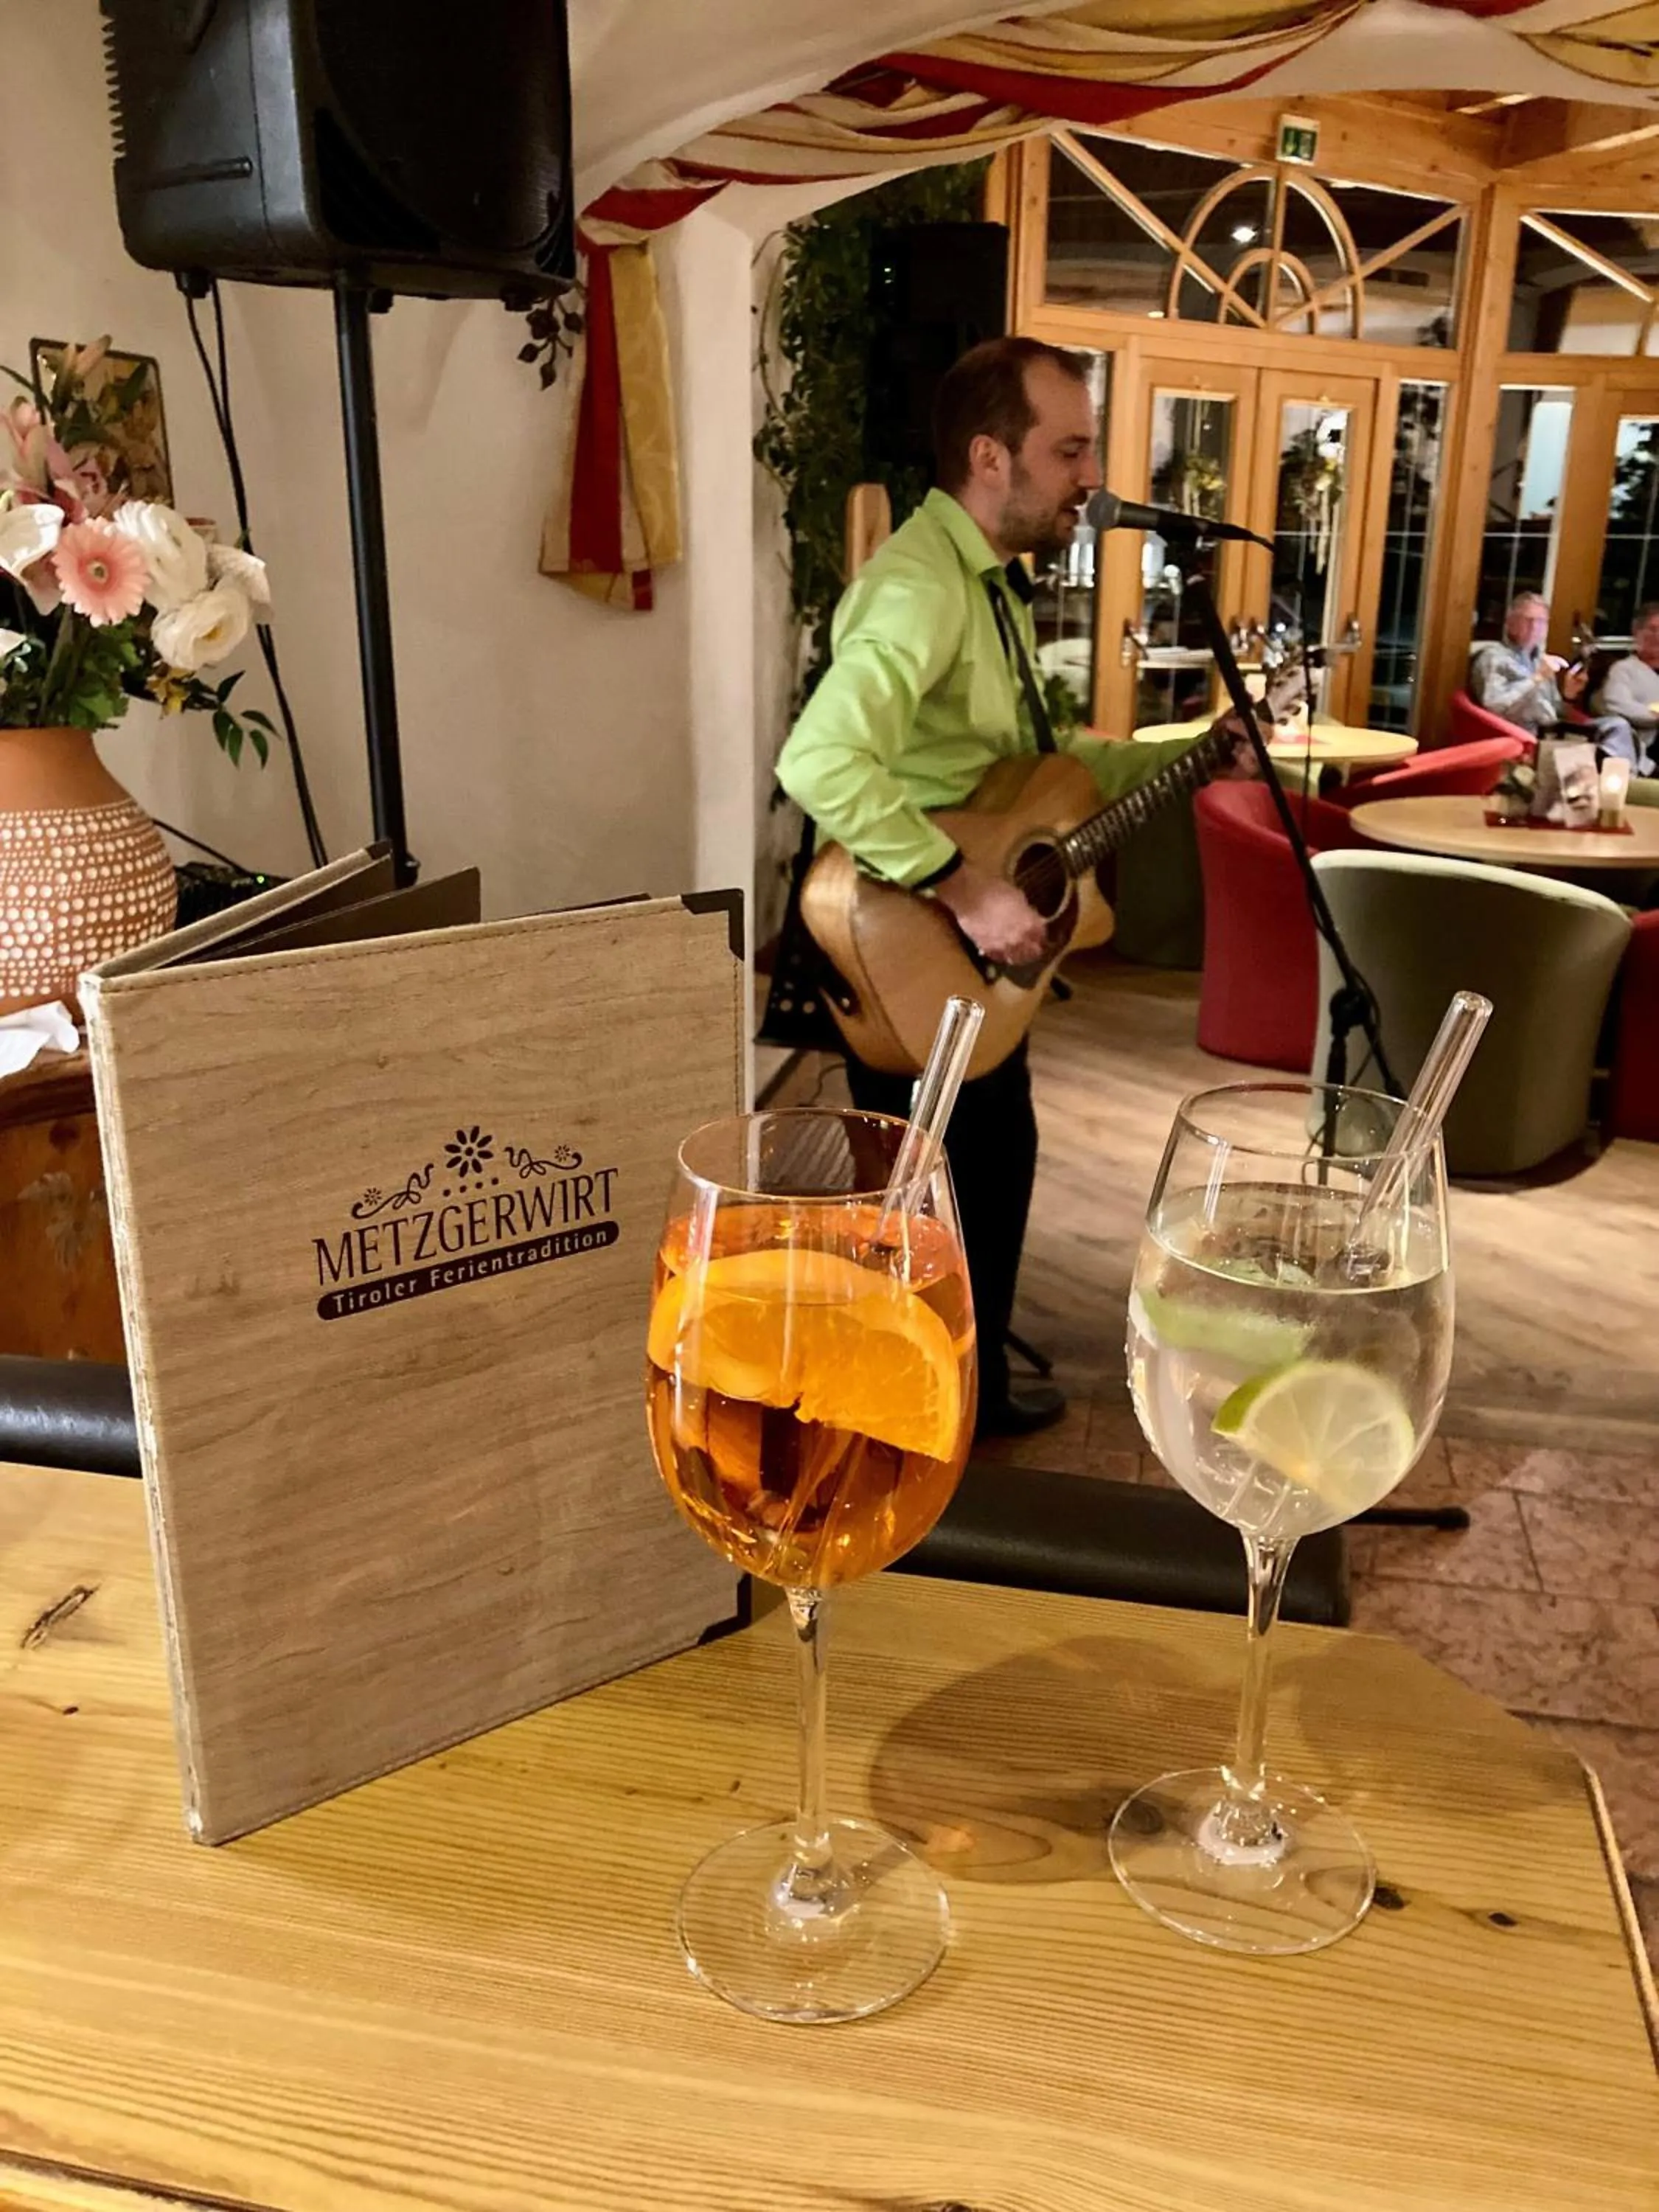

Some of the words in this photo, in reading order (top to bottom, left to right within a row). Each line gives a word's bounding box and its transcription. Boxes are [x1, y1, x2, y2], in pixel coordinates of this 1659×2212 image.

[312, 1168, 619, 1286] METZGERWIRT
[333, 1279, 417, 1313] Tiroler
[430, 1229, 608, 1287] Ferientradition
